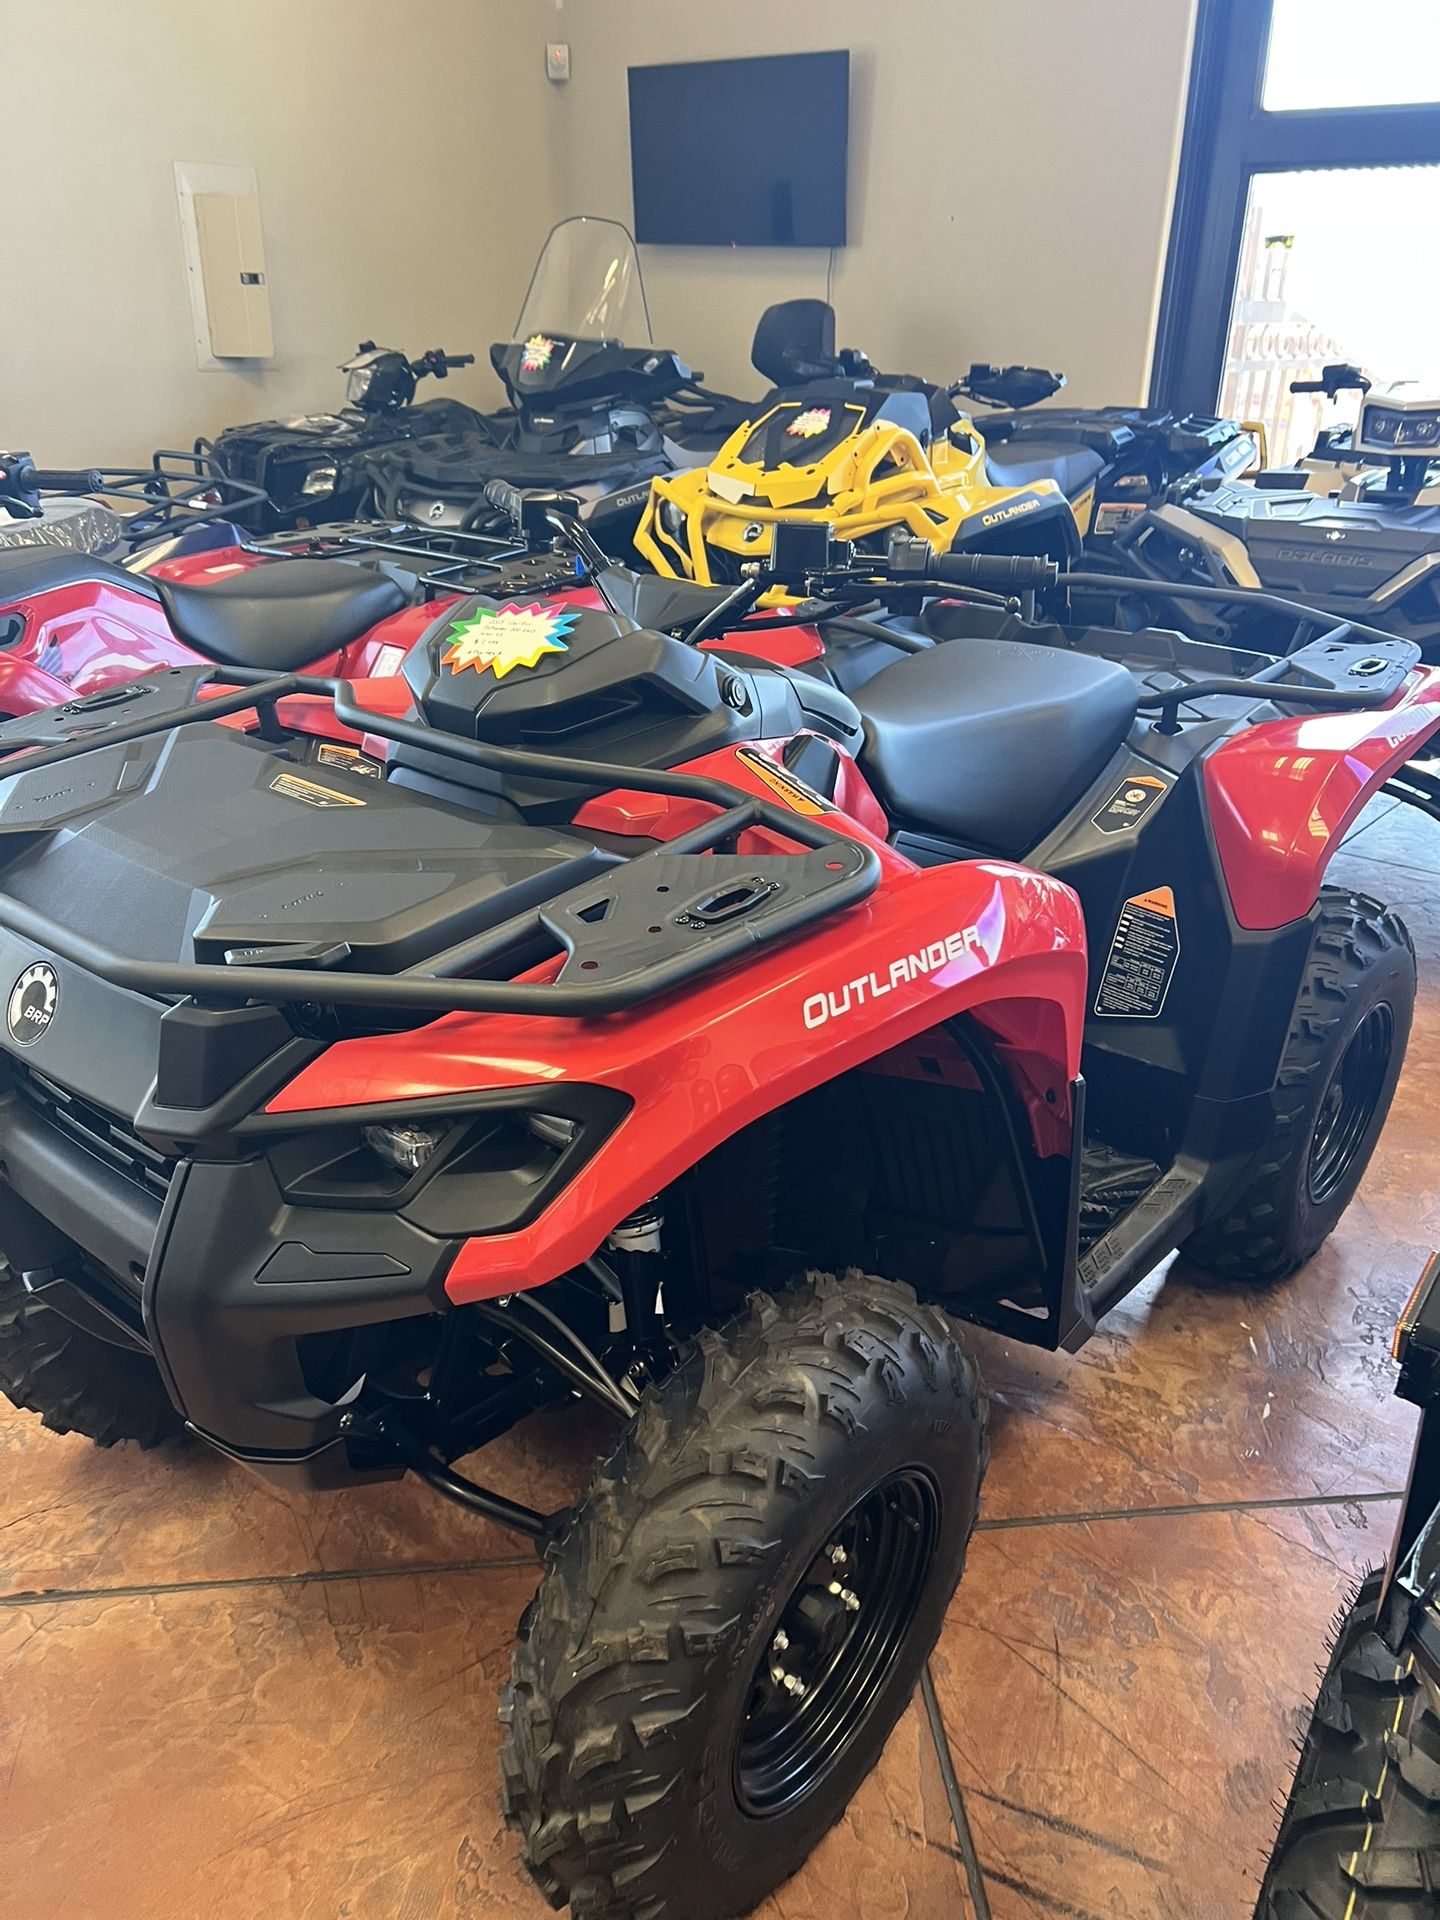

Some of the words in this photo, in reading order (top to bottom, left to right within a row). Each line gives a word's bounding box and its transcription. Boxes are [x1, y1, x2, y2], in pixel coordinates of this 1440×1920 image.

[616, 490, 650, 507] OUTLA
[982, 499, 1040, 526] OUTLANDER
[1277, 547, 1376, 568] POLARIS
[802, 925, 982, 1030] OUTLANDER
[23, 1004, 50, 1026] BRP
